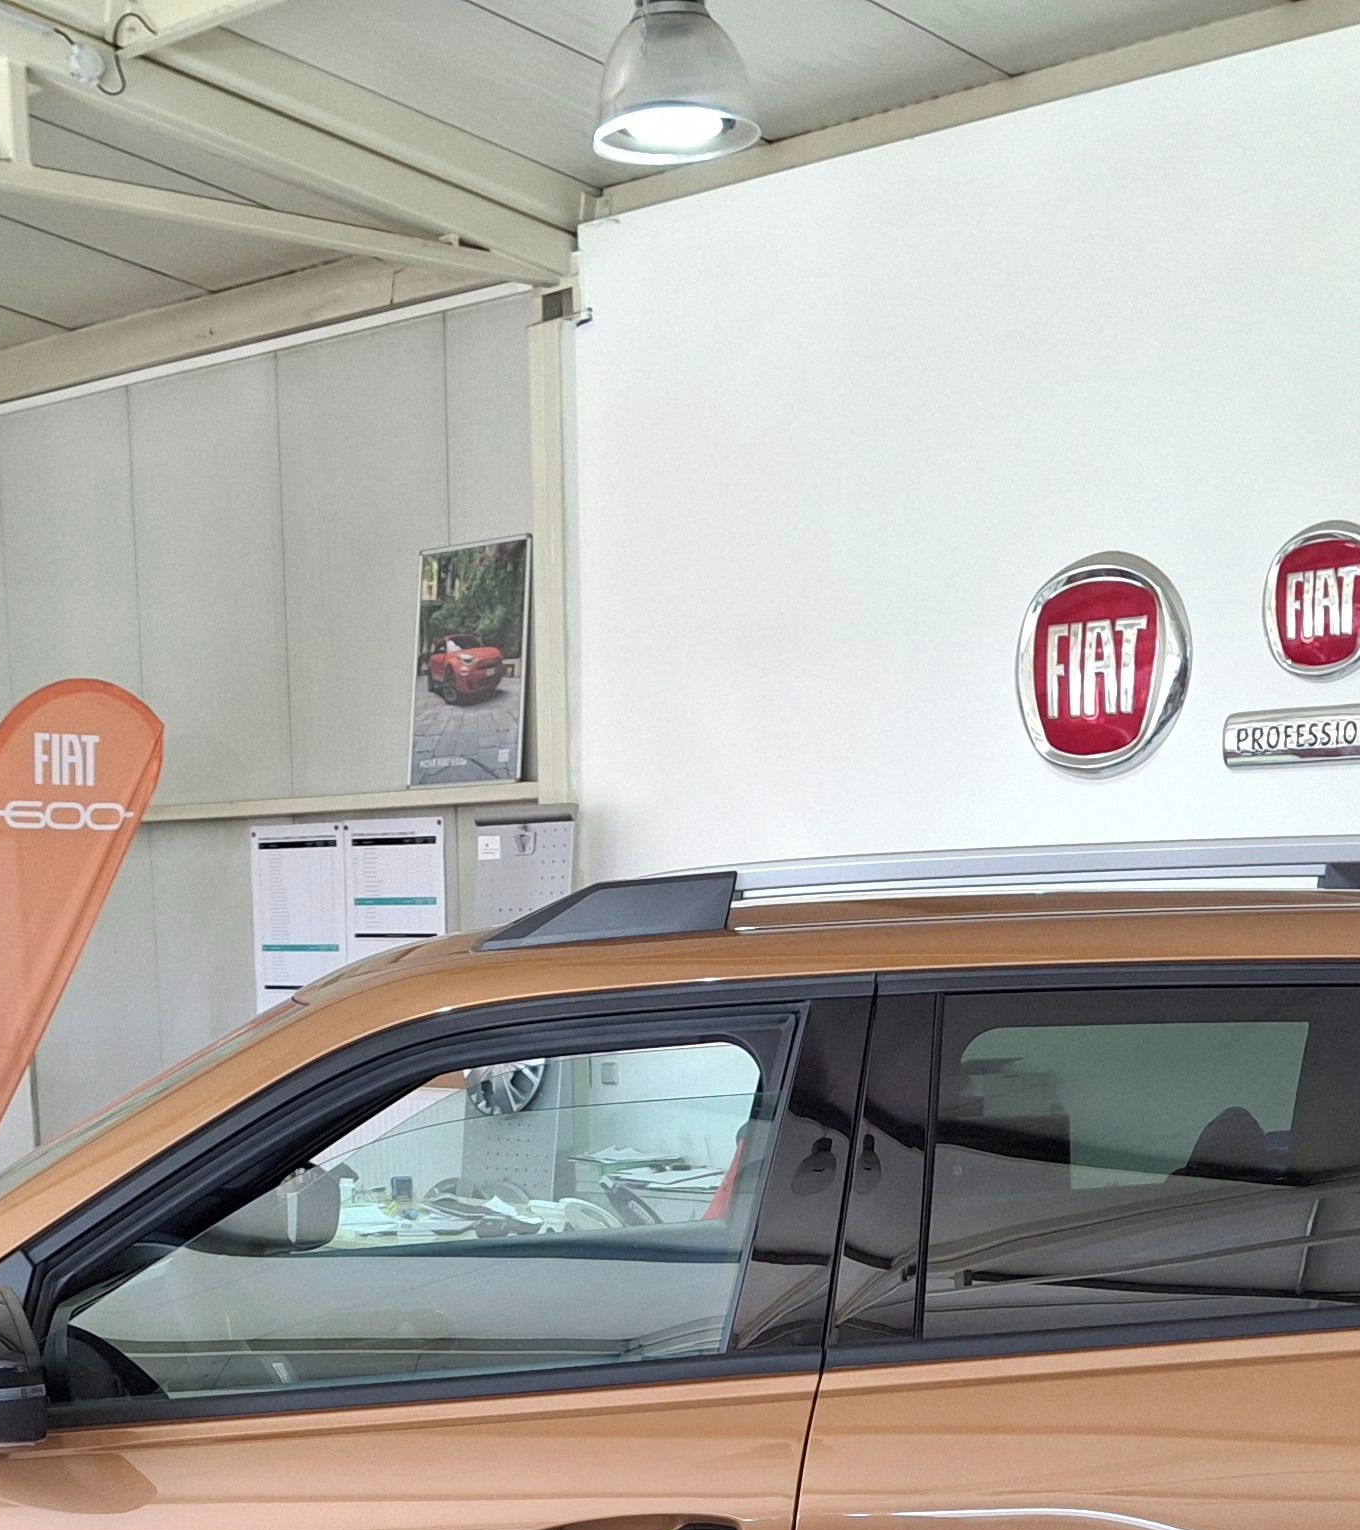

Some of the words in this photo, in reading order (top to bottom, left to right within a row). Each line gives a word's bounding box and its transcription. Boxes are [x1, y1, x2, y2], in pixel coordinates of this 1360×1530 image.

[1046, 615, 1149, 720] FIAT
[33, 732, 100, 786] FIAT
[0, 800, 128, 831] 600
